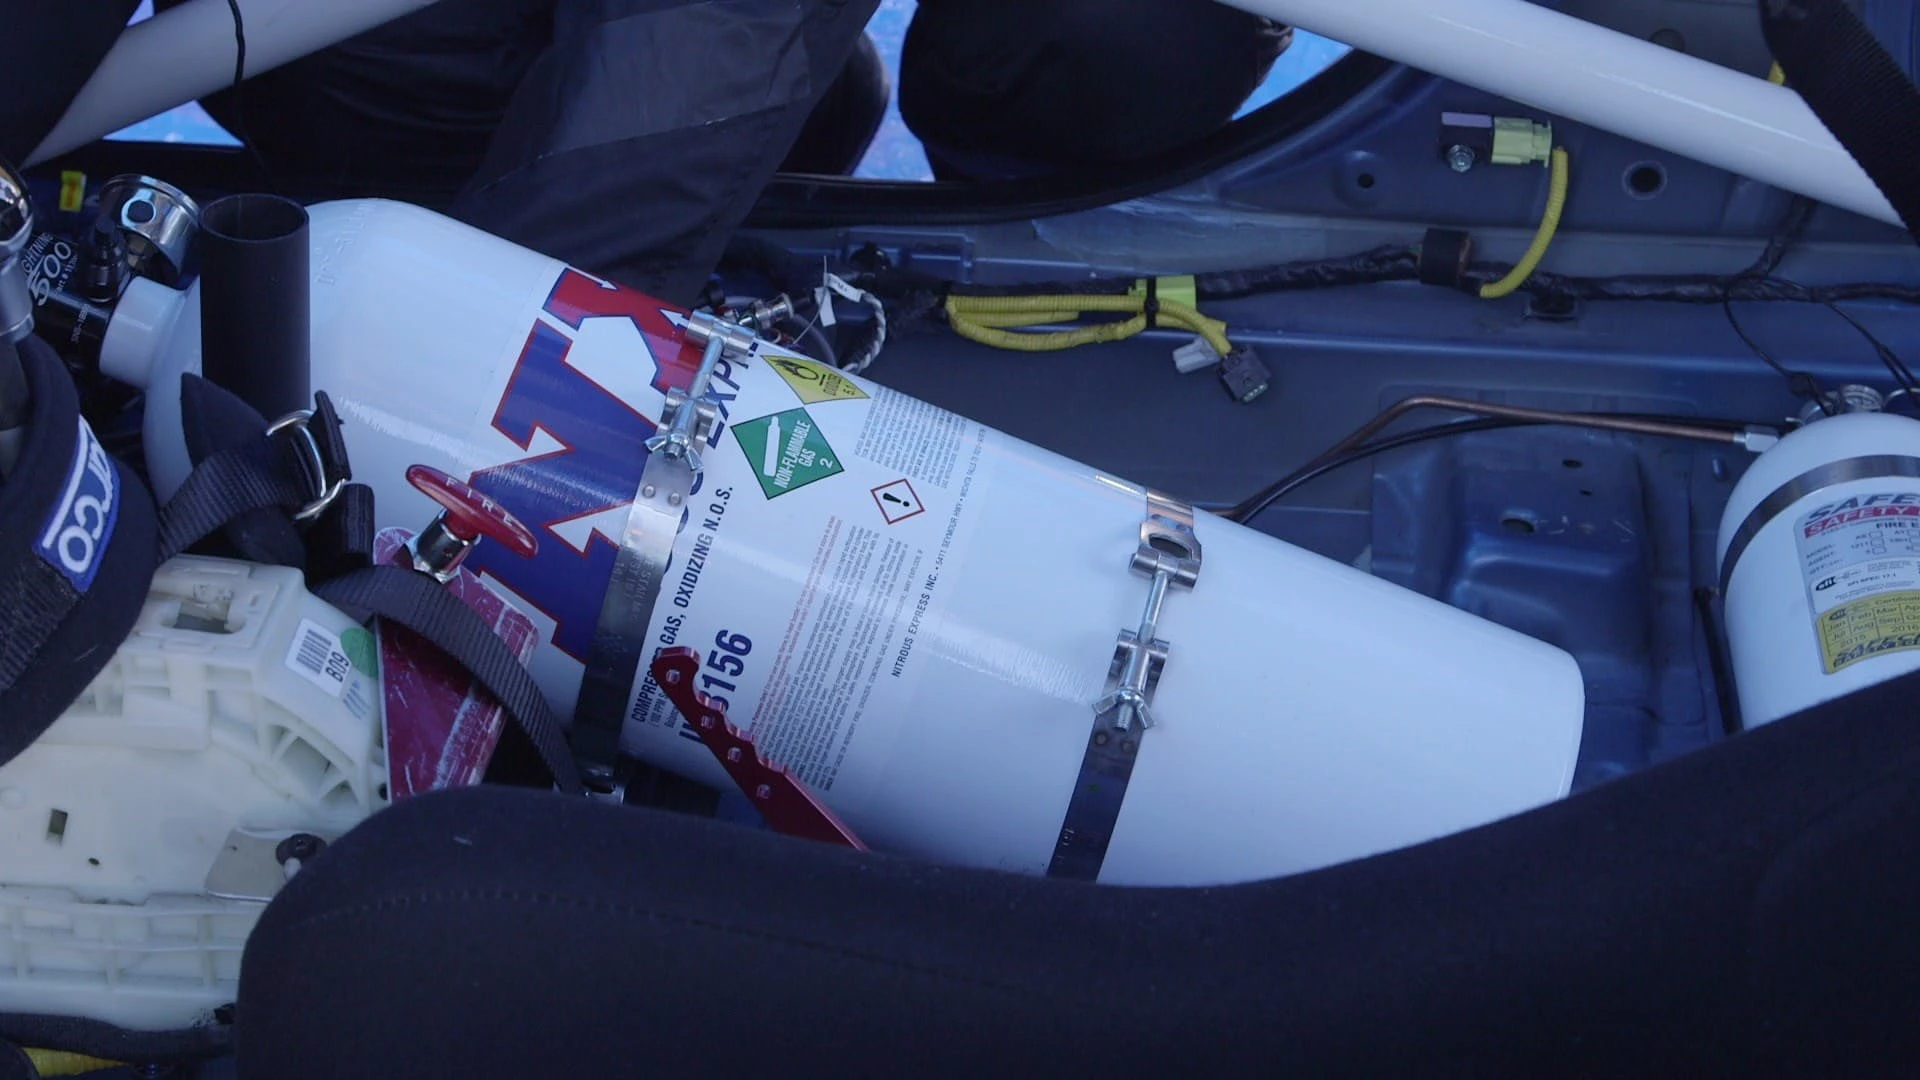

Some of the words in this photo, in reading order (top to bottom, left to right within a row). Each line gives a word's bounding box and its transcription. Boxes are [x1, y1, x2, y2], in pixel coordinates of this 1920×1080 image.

[28, 242, 72, 306] 500
[774, 419, 812, 489] NON-FLAMMABLE
[799, 449, 816, 468] GAS
[820, 458, 833, 469] 2
[658, 609, 686, 646] GAS,
[672, 532, 715, 609] OXIDIZING
[702, 482, 733, 531] N.O.S.
[890, 635, 914, 678] NITROUS
[906, 592, 930, 635] EXPRESS
[923, 570, 939, 591] INC.
[325, 651, 350, 683] B09
